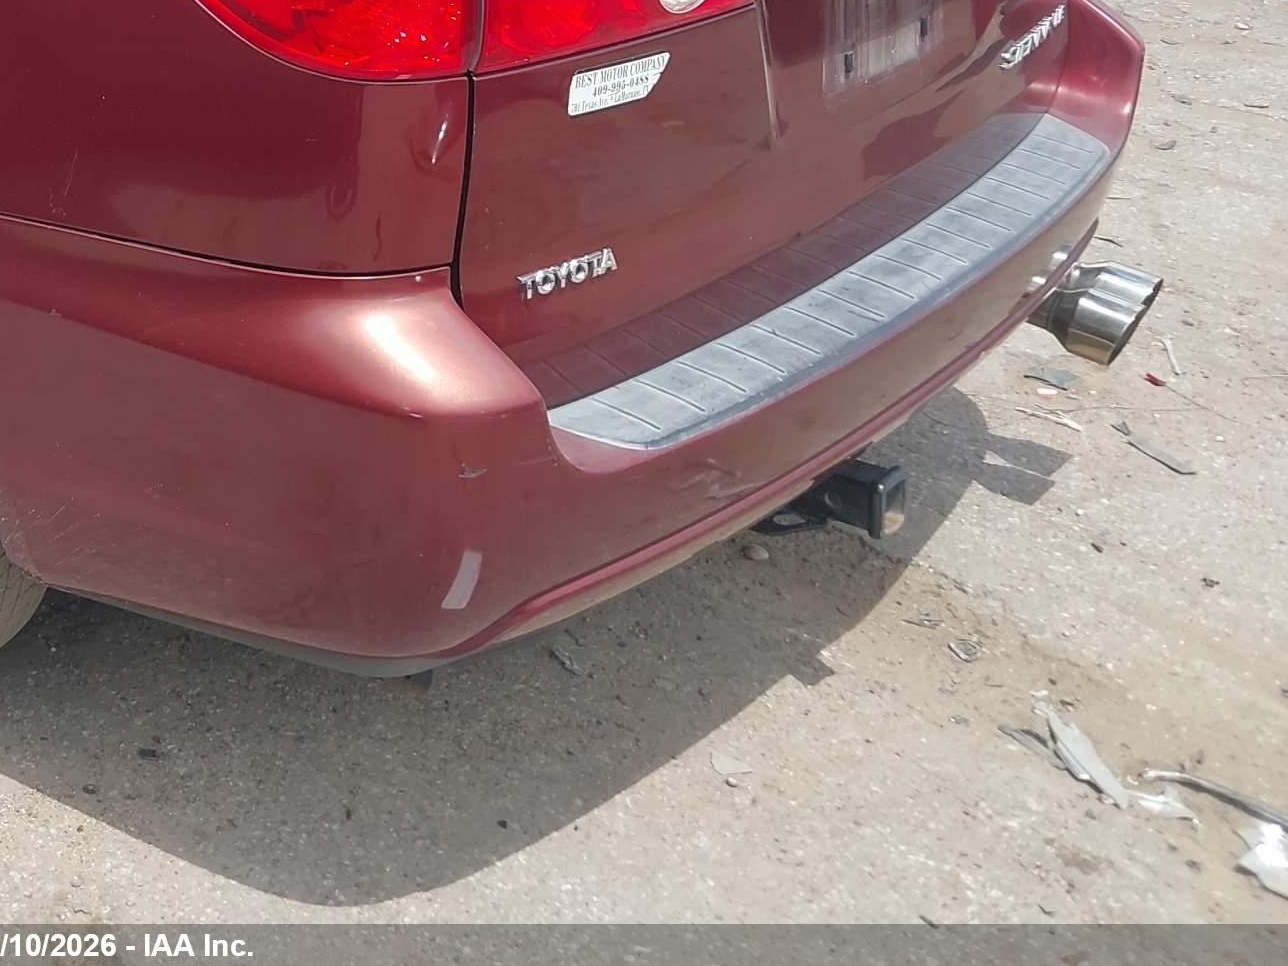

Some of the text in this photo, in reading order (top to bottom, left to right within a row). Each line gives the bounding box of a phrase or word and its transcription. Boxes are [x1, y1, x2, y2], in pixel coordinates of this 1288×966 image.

[600, 65, 629, 84] MOTOR
[630, 54, 667, 76] COMPANY
[516, 247, 618, 300] TOYOTA
